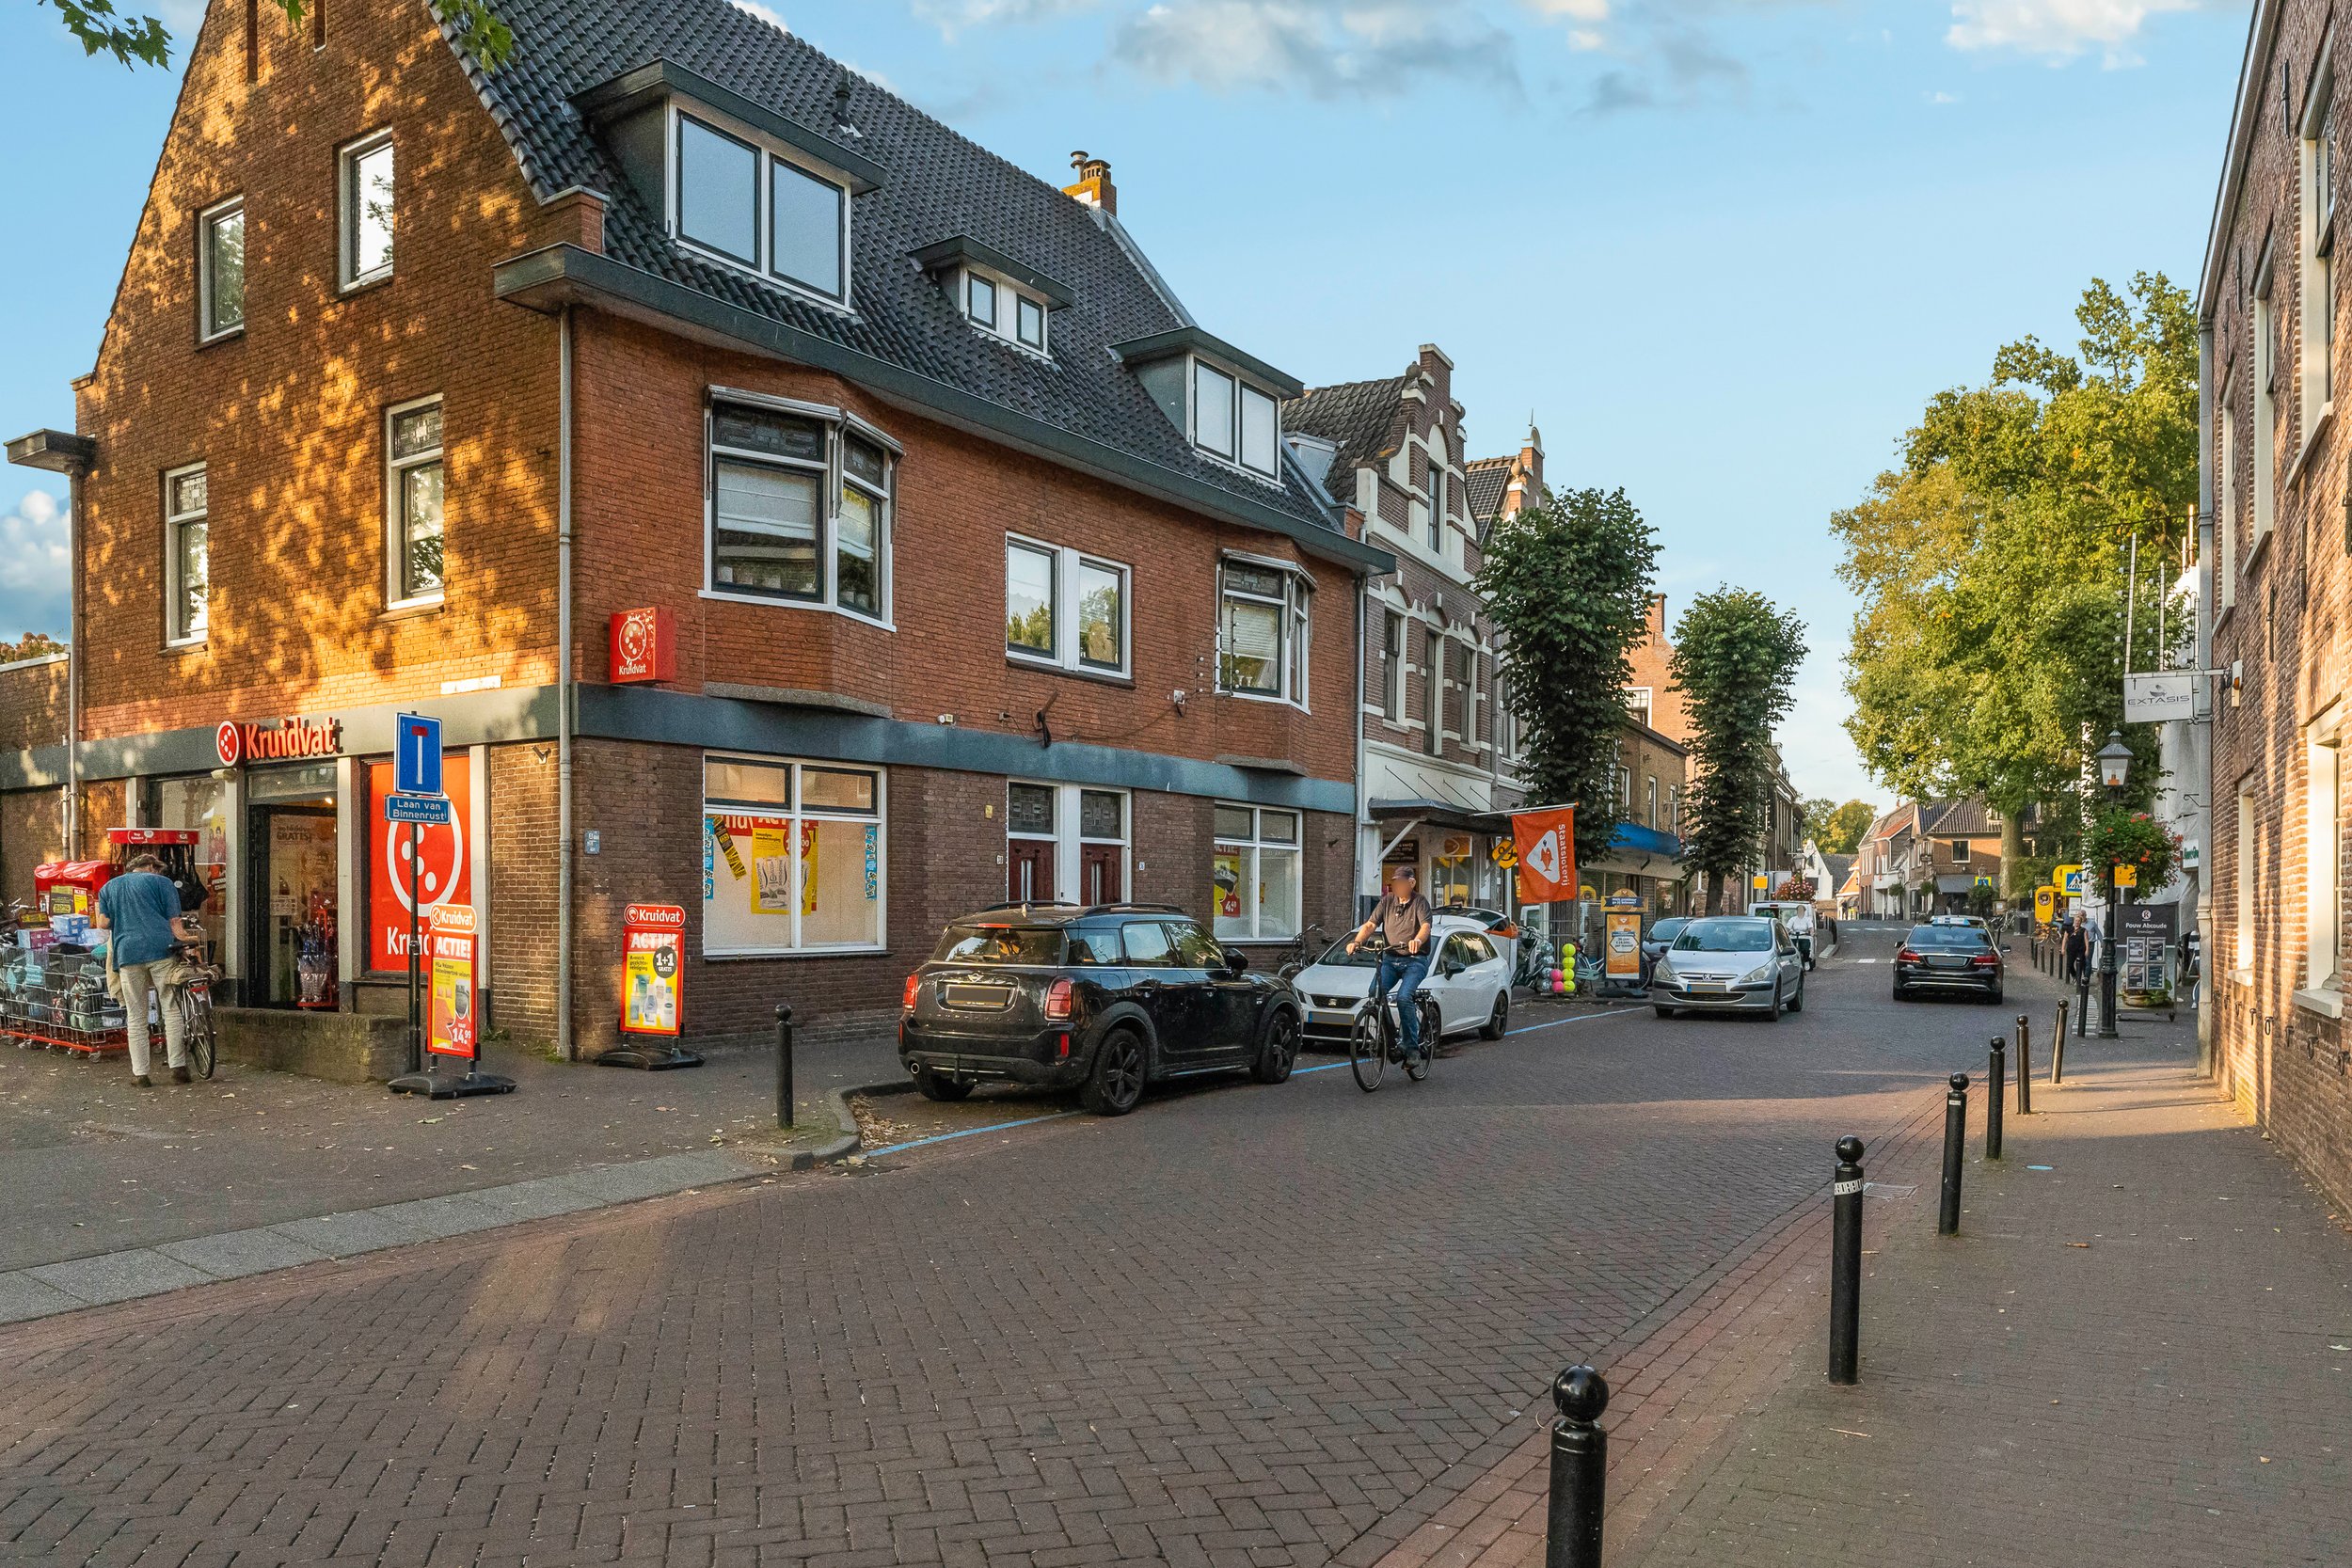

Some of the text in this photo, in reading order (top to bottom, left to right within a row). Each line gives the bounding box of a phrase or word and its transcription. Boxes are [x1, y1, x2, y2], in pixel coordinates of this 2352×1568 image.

[619, 664, 646, 675] Kruidvat
[2127, 695, 2190, 705] EXTASIS
[246, 717, 336, 759] Kruidvat
[397, 800, 441, 811] Laan van
[392, 809, 445, 820] Binnenrust
[1558, 823, 1570, 886] Staatsloterij
[441, 910, 473, 926] Kruidvat
[639, 909, 680, 922] Kruidvat
[436, 936, 471, 959] ACTIE!
[630, 932, 678, 950] ACTIE!
[656, 953, 675, 966] 1+1
